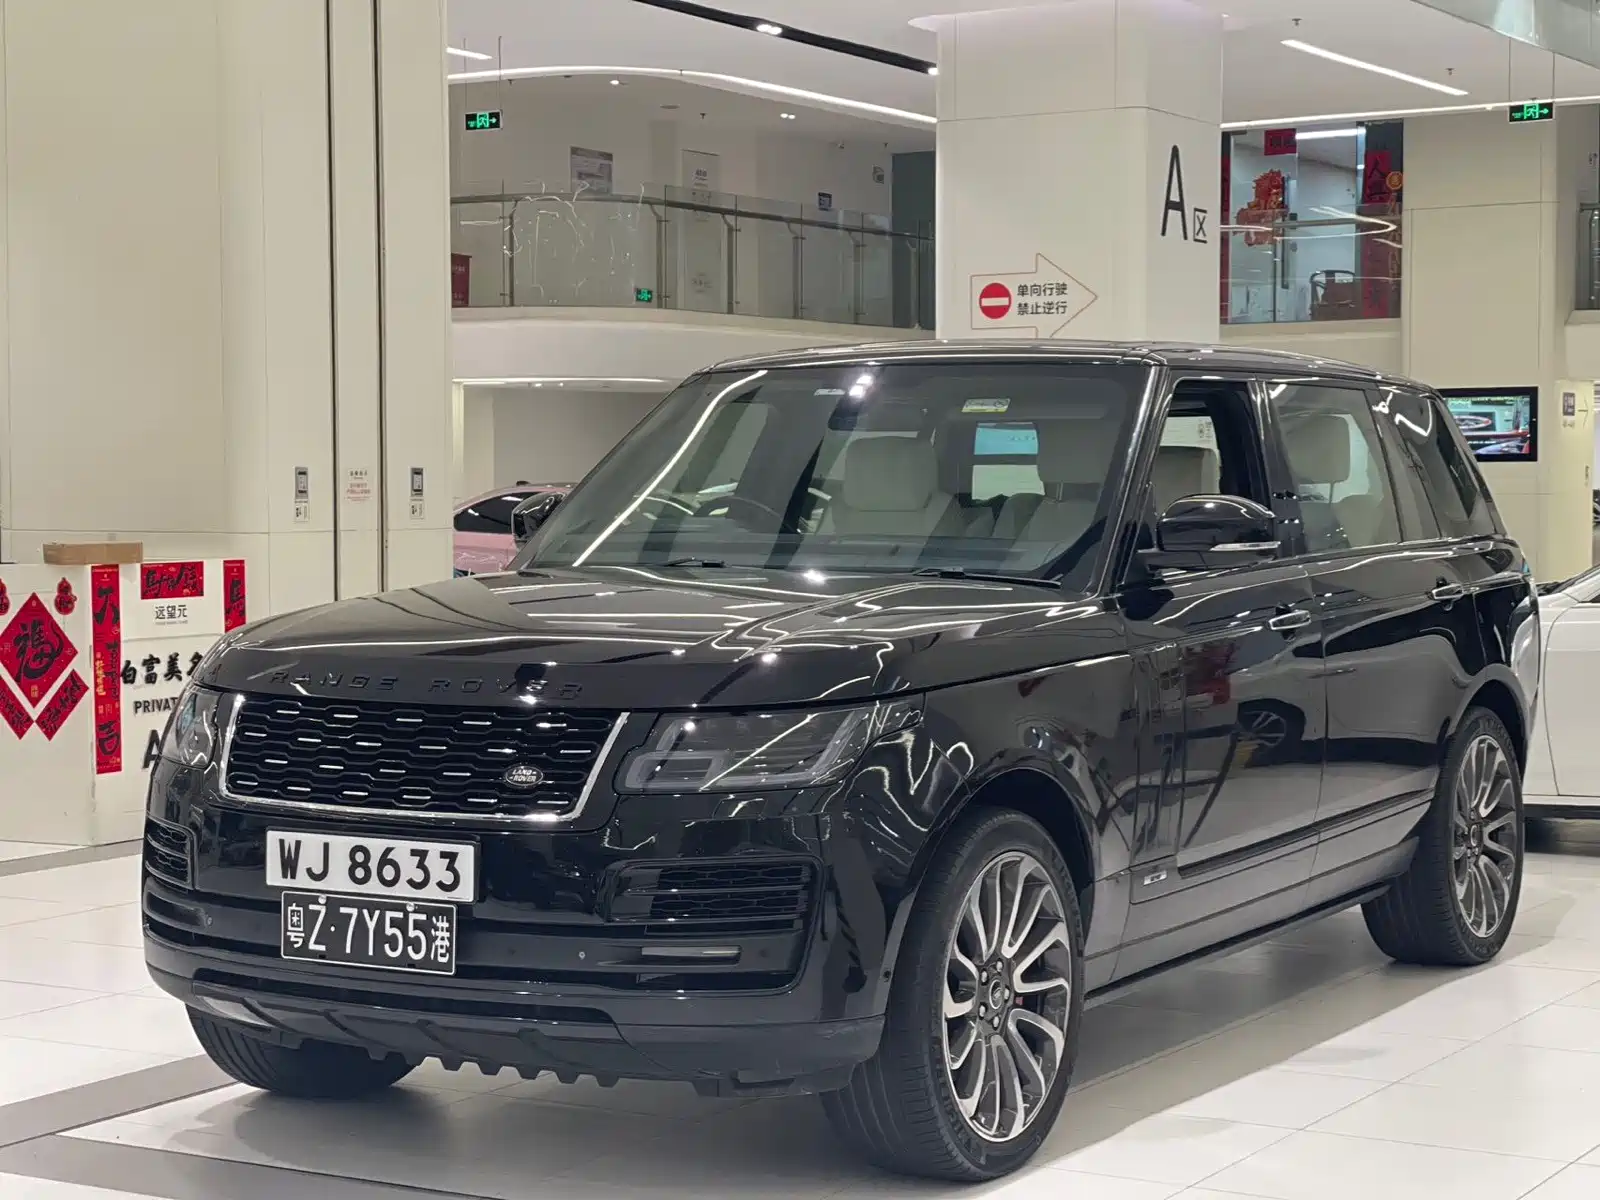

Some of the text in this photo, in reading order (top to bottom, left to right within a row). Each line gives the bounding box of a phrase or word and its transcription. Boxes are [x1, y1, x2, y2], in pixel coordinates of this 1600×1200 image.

[1017, 282, 1068, 297] 单向行驶
[1017, 301, 1068, 315] 禁止逆行
[155, 604, 188, 620] 远望元
[269, 671, 584, 699] RANGE ROVER
[278, 838, 461, 892] WJ 8633
